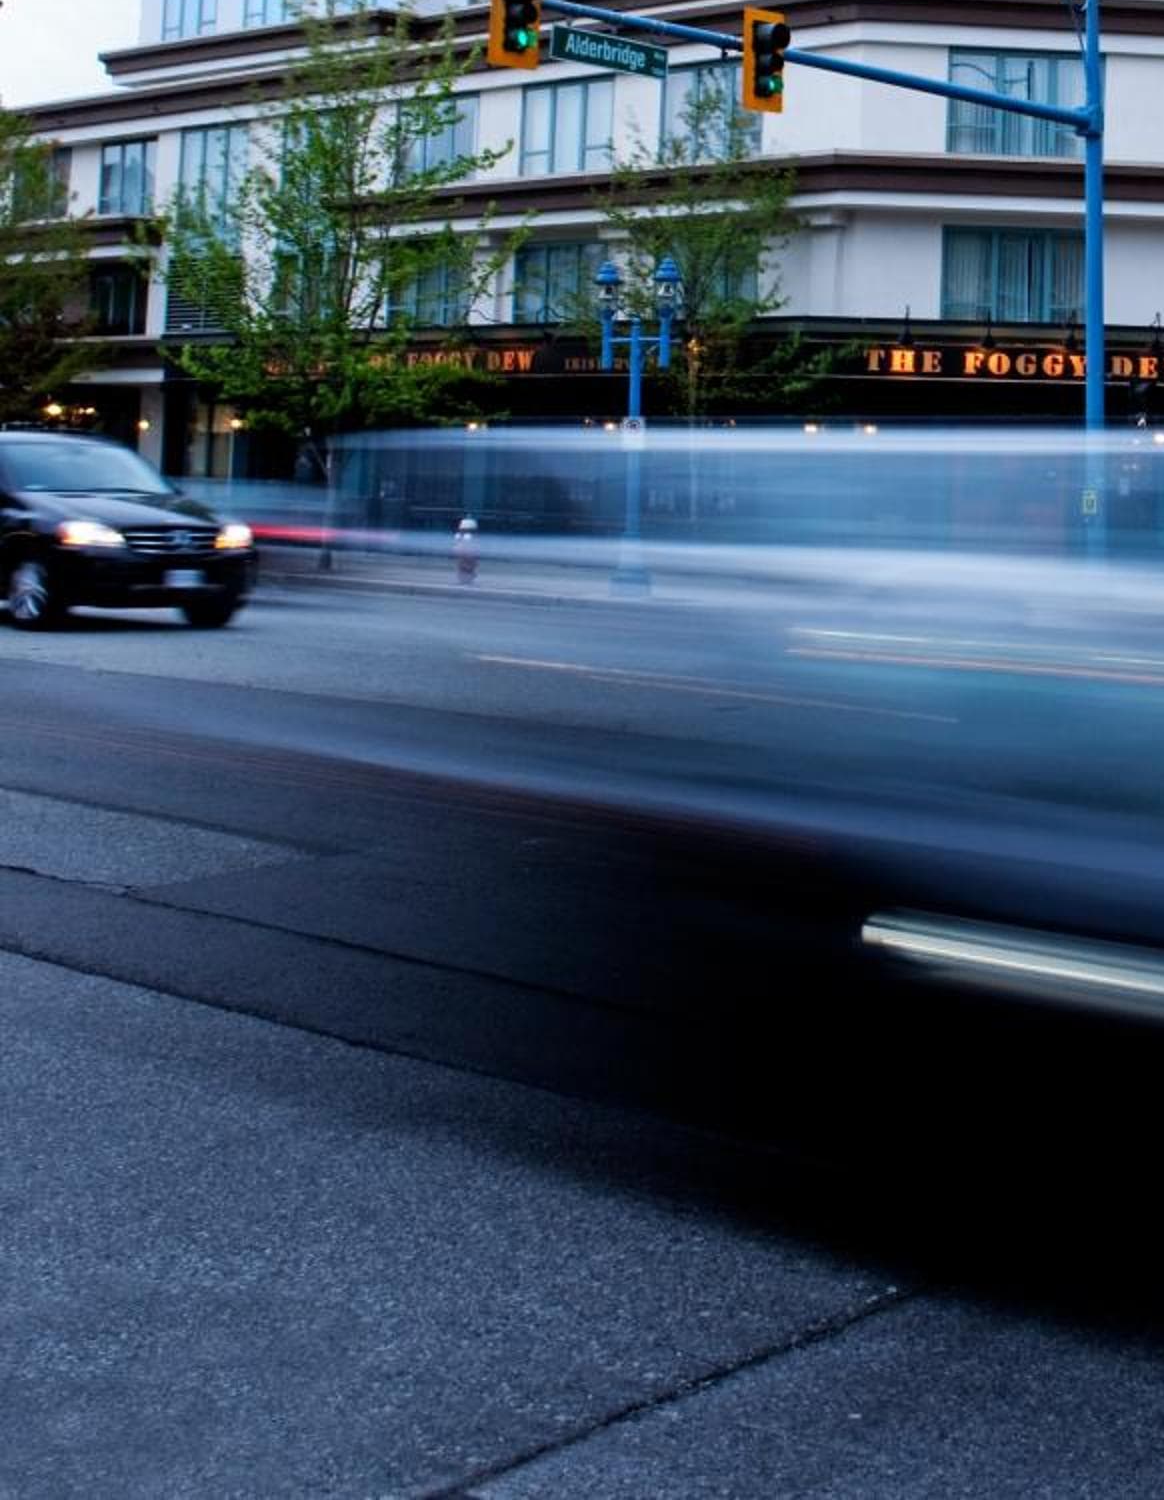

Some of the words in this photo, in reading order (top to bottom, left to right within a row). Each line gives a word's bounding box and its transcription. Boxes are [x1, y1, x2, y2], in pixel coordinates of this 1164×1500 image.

[565, 33, 647, 71] Alderbridge
[486, 349, 536, 373] DEW
[864, 348, 943, 374] THE
[963, 352, 1088, 377] FOGGY
